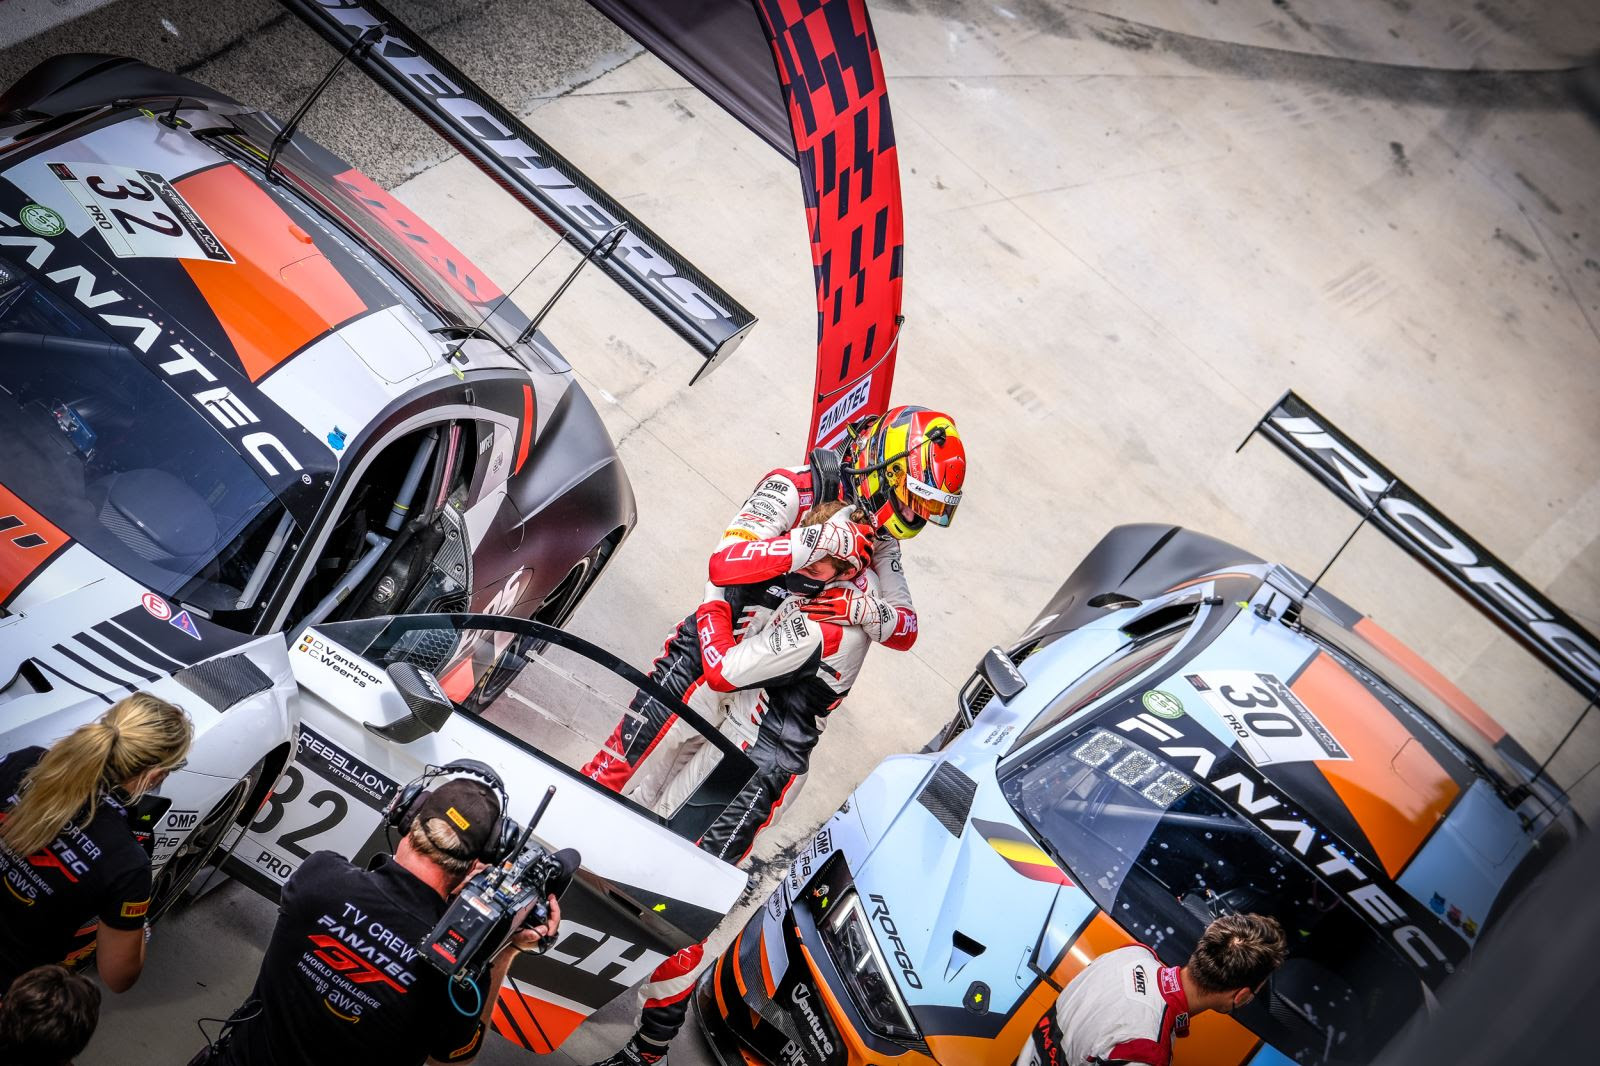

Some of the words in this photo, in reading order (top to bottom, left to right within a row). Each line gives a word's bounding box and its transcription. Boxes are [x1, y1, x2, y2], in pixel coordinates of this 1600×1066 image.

[85, 205, 113, 230] PRO
[86, 175, 184, 237] 32
[818, 380, 870, 439] FANATEC
[764, 481, 789, 493] OMP
[806, 528, 817, 548] OMP
[793, 617, 808, 638] OMP
[1219, 685, 1303, 738] 30
[1224, 714, 1250, 739] PRO
[167, 813, 198, 828] OMP
[816, 830, 830, 855] OMP
[1116, 713, 1446, 969] FANATEC
[255, 850, 293, 880] PRO
[8, 867, 38, 899] aws
[342, 902, 368, 925] TV
[368, 922, 419, 963] CREW
[869, 894, 923, 990] IROFGO
[317, 914, 417, 986] FANATEC
[297, 961, 329, 989] POWERED
[302, 951, 332, 977] WORLD
[332, 975, 381, 1009] CHALLENGE
[315, 984, 327, 995] BY
[1134, 970, 1146, 996] WRT
[328, 989, 364, 1016] aws
[791, 982, 834, 1055] Venture
